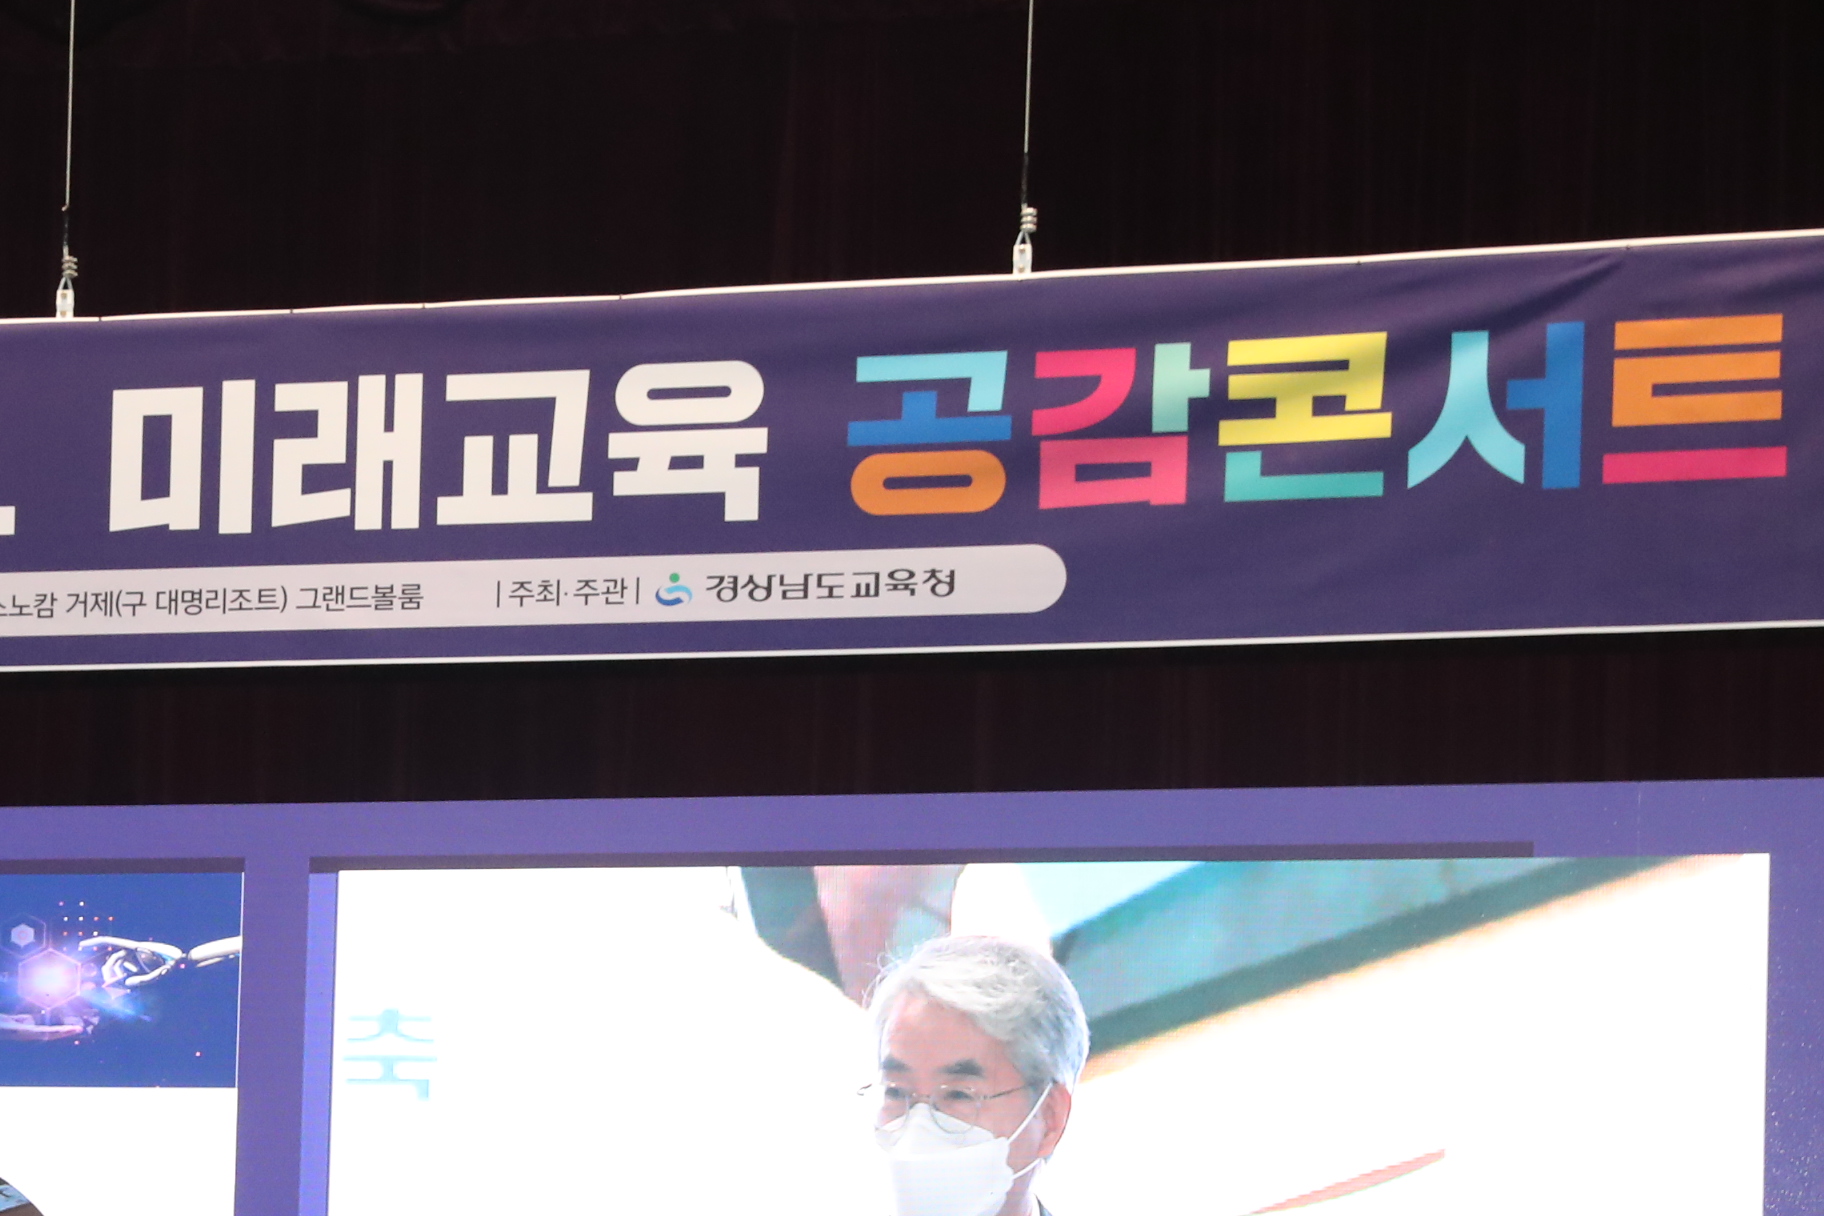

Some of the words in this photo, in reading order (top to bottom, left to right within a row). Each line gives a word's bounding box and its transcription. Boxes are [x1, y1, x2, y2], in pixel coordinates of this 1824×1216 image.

[109, 360, 767, 534] 미래교육
[846, 313, 1787, 516] 공감콘서트
[65, 588, 147, 619] 거제(구
[155, 584, 287, 616] 대명리조트)
[296, 582, 423, 612] 그랜드볼룸
[705, 568, 957, 603] 경상남도교육청
[343, 1008, 438, 1101] 축
